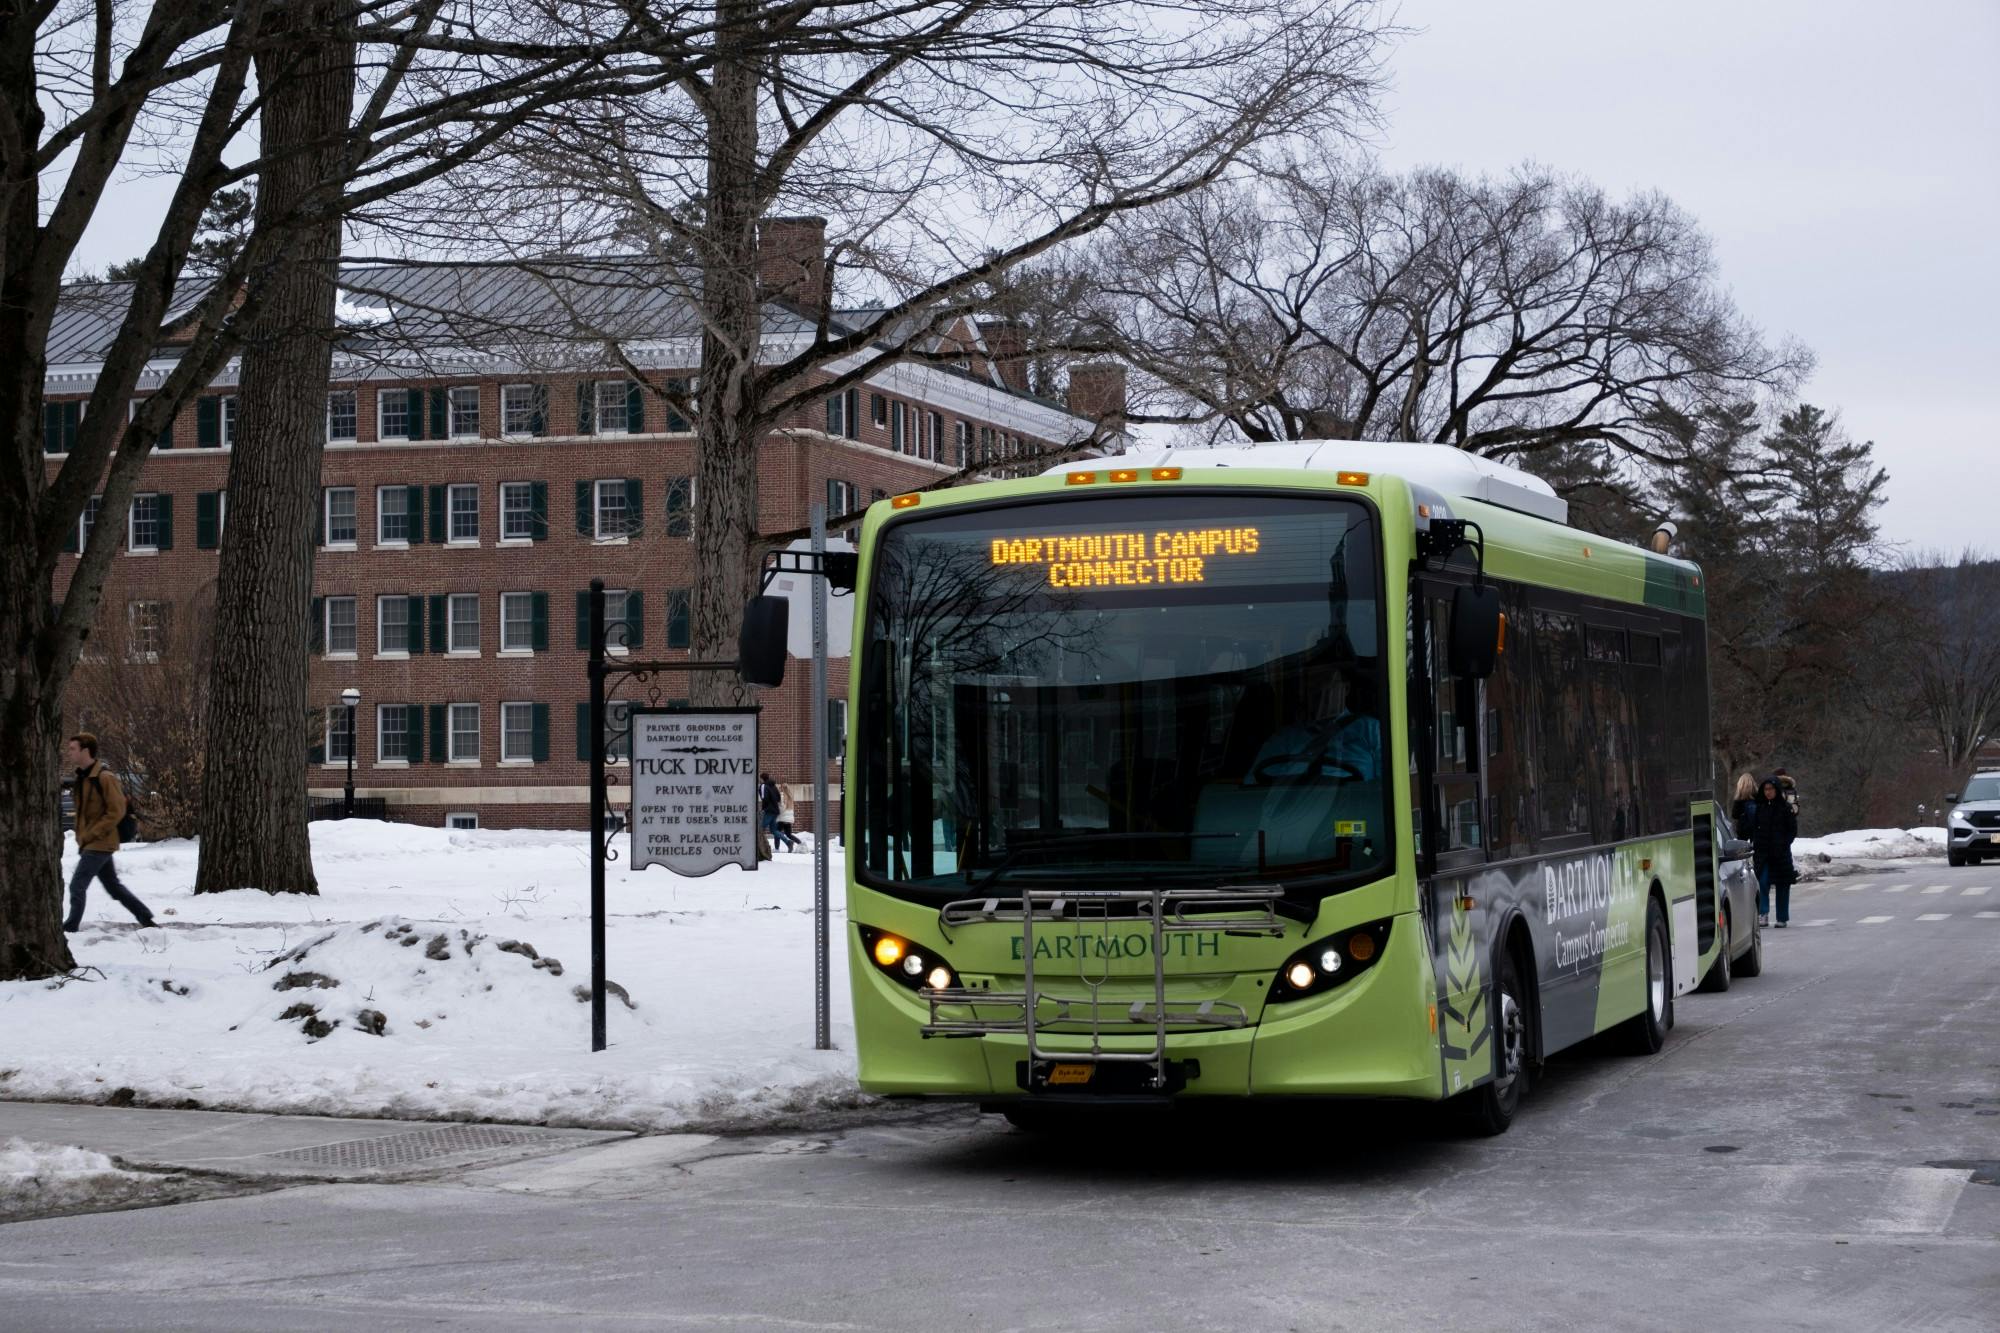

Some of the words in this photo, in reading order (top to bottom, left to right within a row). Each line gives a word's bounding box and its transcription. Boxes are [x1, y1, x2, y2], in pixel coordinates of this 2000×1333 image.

[992, 533, 1145, 564] DARTMOUTH
[1154, 528, 1259, 557] CAMPUS
[1050, 557, 1204, 587] CONNECTOR
[647, 724, 680, 732] PRIVATE
[687, 724, 726, 732] GROUNDS
[733, 724, 742, 732] OF
[647, 735, 698, 743] DARTMOUTH
[705, 735, 743, 743] COLLEGE
[636, 759, 686, 775] TUCK
[695, 759, 753, 774] DRIVE
[656, 786, 702, 794] PRIVATE
[712, 786, 734, 794] WAY
[641, 806, 666, 814] OPEN
[672, 806, 684, 814] TO
[689, 806, 708, 814] THE
[714, 805, 747, 813] PUBLIC
[642, 817, 654, 825] AT
[661, 817, 680, 825] THE
[686, 815, 718, 824] USER'S
[724, 816, 748, 824] RISK
[649, 835, 670, 843] FOR
[680, 835, 740, 843] PLEASURE
[647, 847, 702, 855] VEHICLES
[714, 846, 742, 855] ONLY
[1545, 851, 1634, 925] DARTMOUTH
[1555, 930, 1589, 976] Campus
[1590, 920, 1629, 956] Connector
